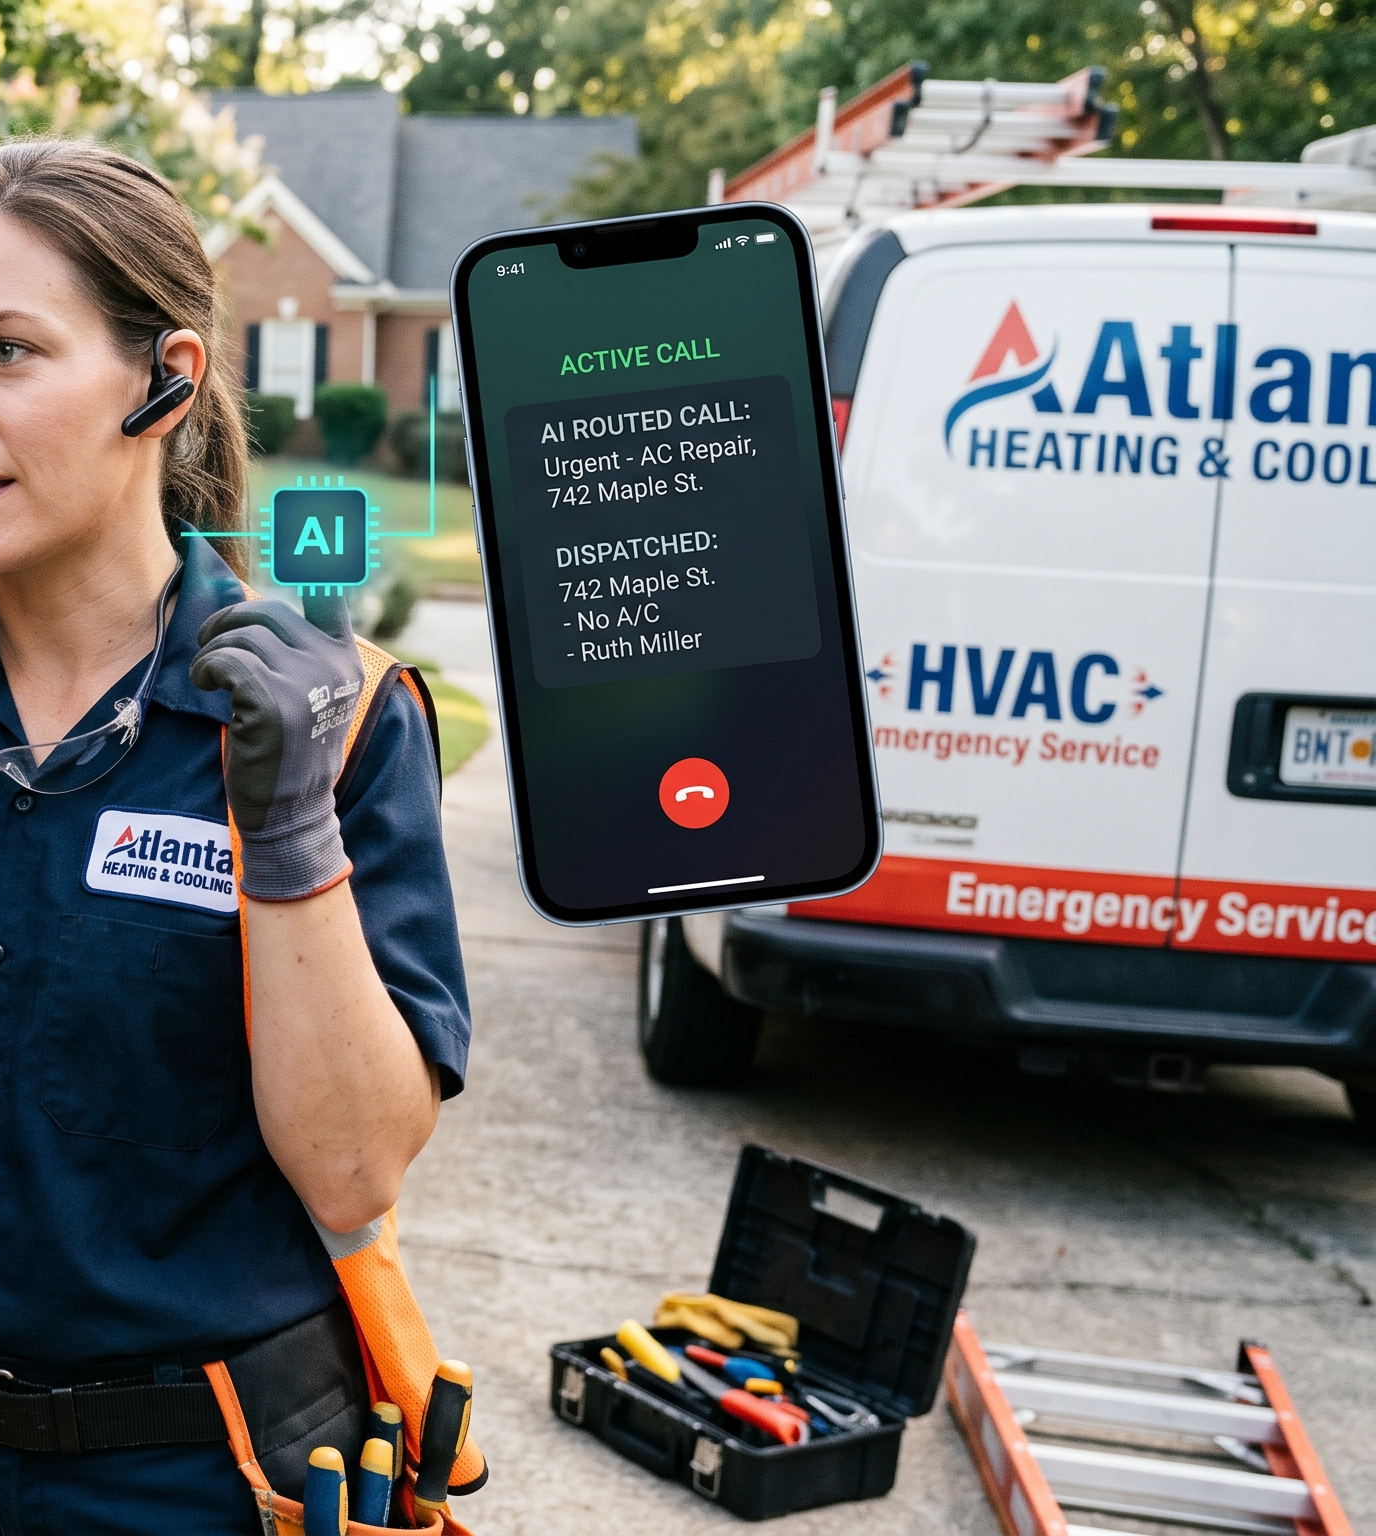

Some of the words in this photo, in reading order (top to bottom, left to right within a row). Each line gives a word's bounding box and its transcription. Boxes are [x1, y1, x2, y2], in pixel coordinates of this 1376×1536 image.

[496, 262, 525, 277] 9:41
[560, 345, 651, 376] ACTIVE
[656, 337, 721, 364] CALL
[1073, 320, 1376, 426] Atlan
[540, 421, 565, 444] AI
[572, 409, 673, 440] ROUTED
[679, 400, 751, 427] CALL:
[544, 451, 621, 480] Urgent
[640, 443, 673, 467] AC
[679, 434, 757, 464] Repair,
[967, 427, 1179, 477] HEATING
[1198, 437, 1231, 479] &
[547, 484, 592, 509] 742
[597, 475, 668, 504] Maple
[674, 472, 704, 493] St.
[556, 530, 718, 568] DISPATCHED:
[558, 578, 604, 603] 742
[609, 569, 680, 598] Maple
[685, 566, 716, 587] St.
[577, 610, 610, 632] No
[616, 602, 660, 628] A/C
[581, 636, 633, 662] Ruth
[639, 629, 703, 655] Miller
[905, 642, 1122, 725] HVAC
[874, 726, 1031, 768] mergency
[1038, 731, 1161, 769] Service
[106, 825, 233, 875] Atlanta
[101, 861, 157, 881] HEATING
[159, 869, 171, 883] &
[174, 870, 233, 895] COOLING
[945, 870, 1210, 943] Emergency
